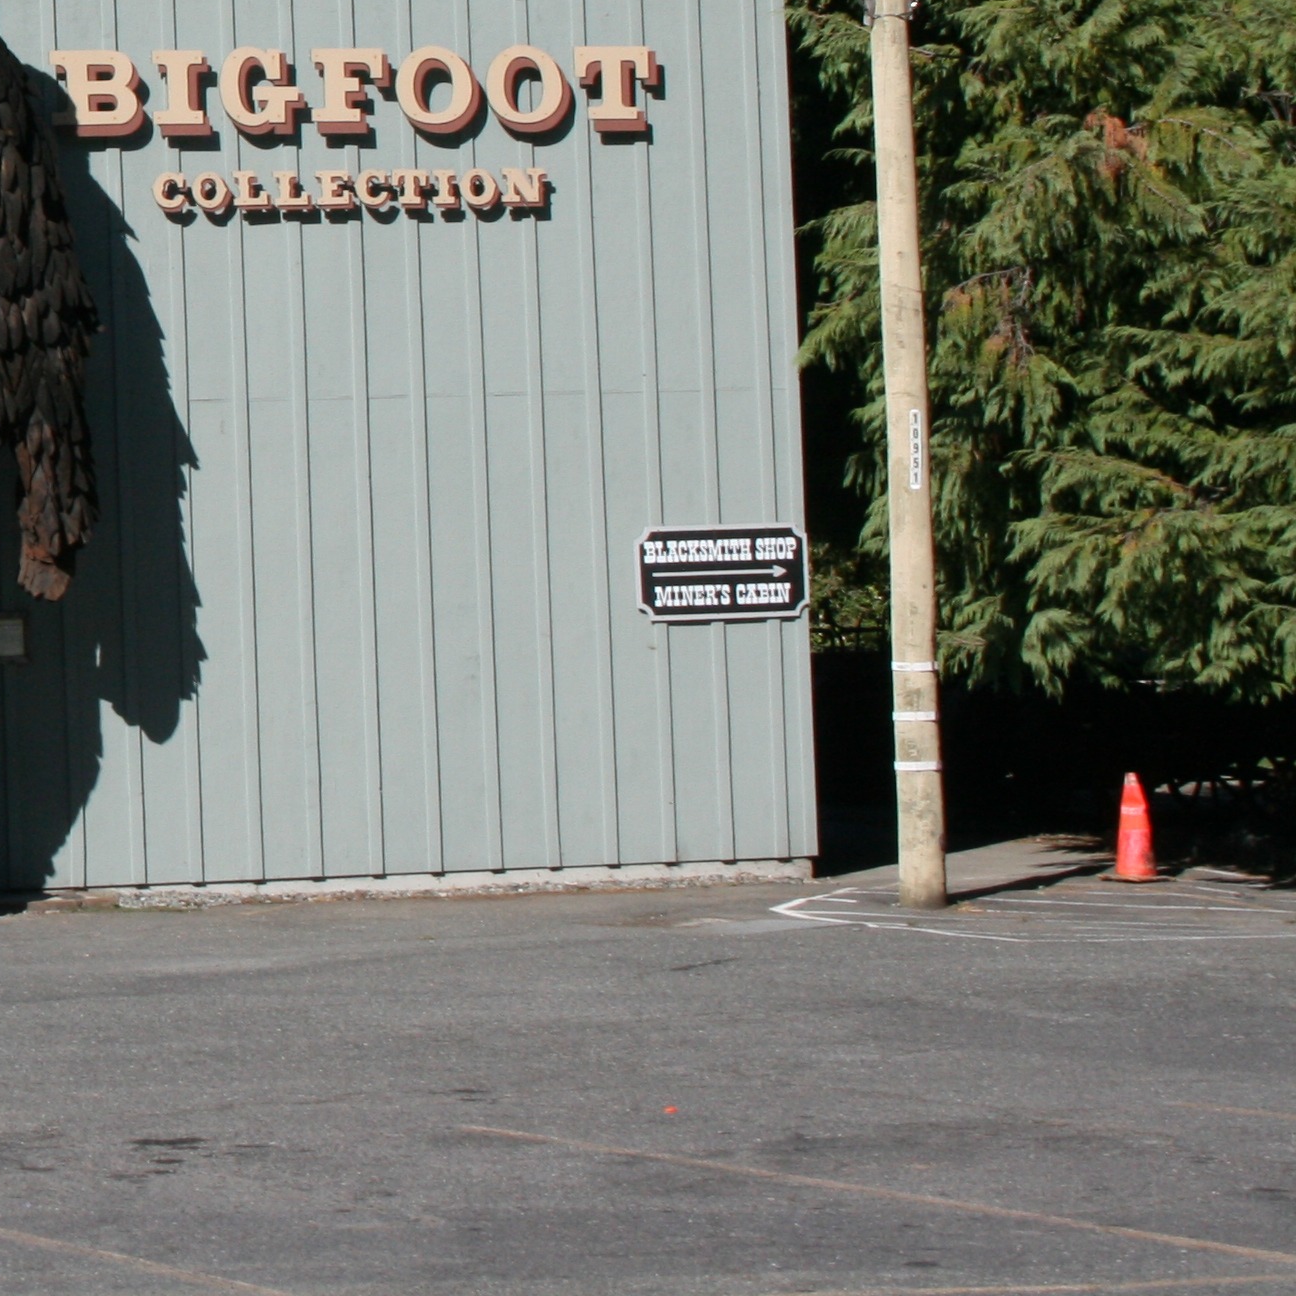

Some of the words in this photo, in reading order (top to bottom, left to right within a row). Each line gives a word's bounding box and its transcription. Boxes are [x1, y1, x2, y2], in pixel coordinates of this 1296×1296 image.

[49, 45, 657, 135] BIGFOOT
[153, 167, 548, 211] COLLECTION
[912, 412, 920, 484] 10951
[643, 538, 753, 564] BLACKSMITH
[755, 536, 797, 561] SHOP
[654, 584, 731, 607] MINER'S
[736, 582, 791, 605] CABIN
